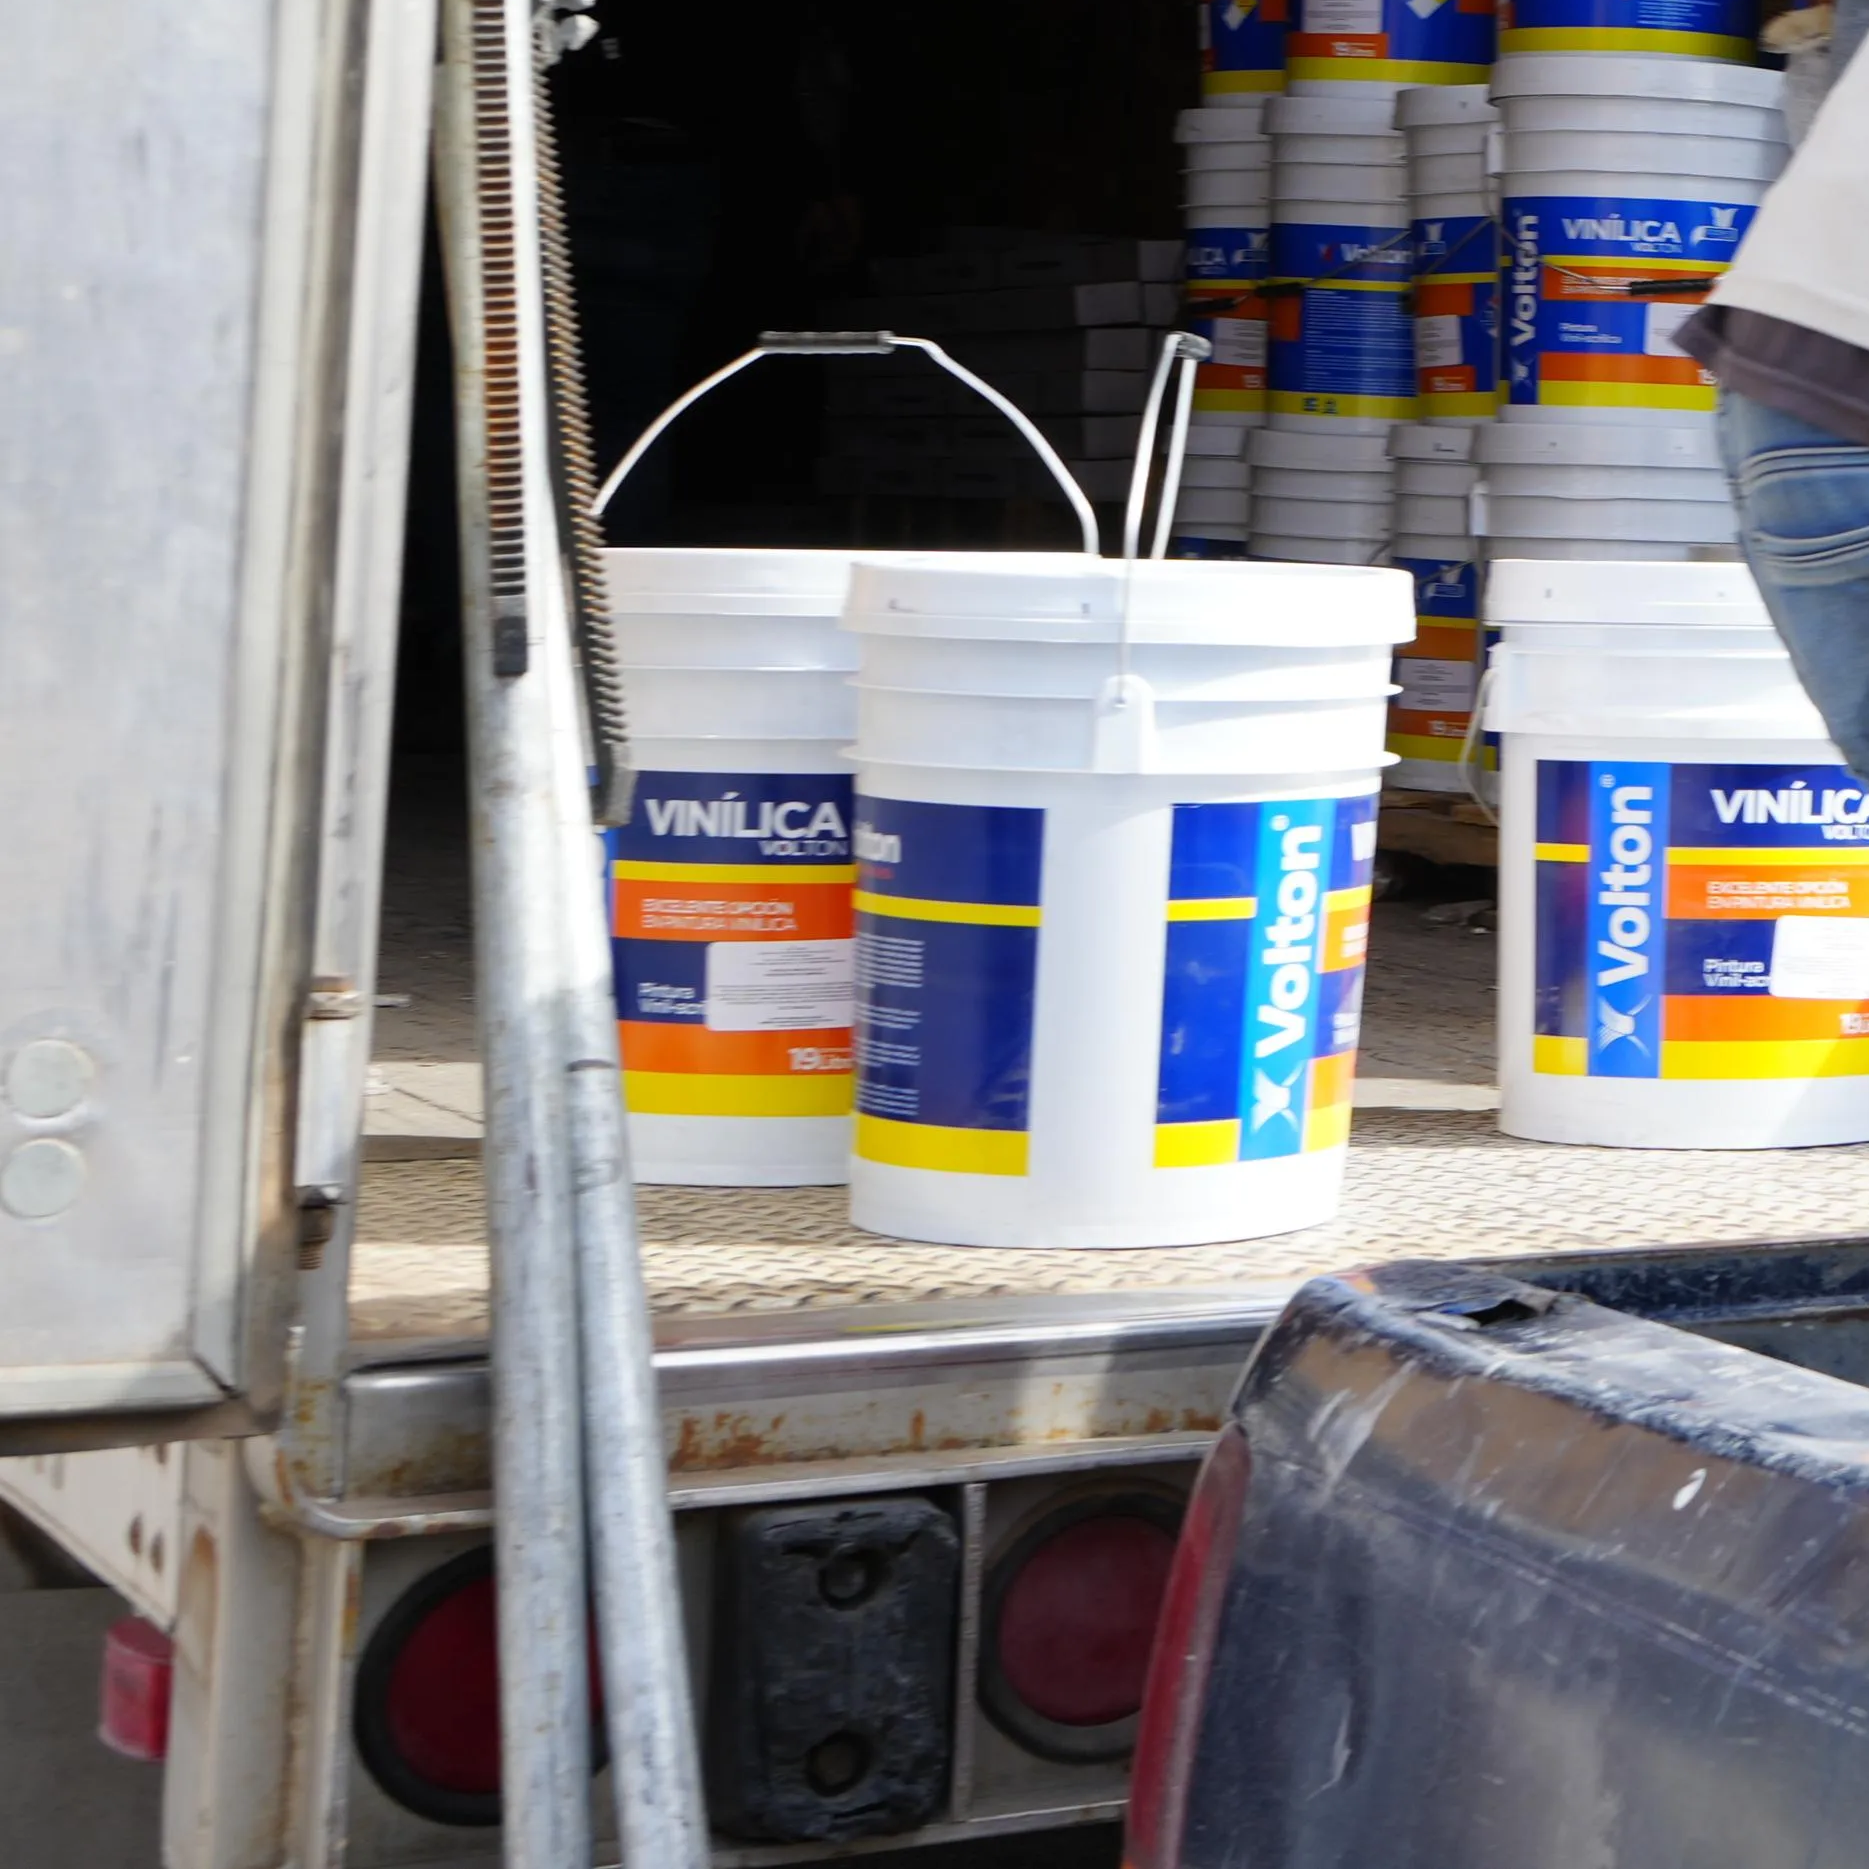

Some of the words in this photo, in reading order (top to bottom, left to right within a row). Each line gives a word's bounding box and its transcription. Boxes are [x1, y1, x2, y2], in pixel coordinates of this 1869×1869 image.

[1561, 213, 1683, 244] VINÍLICA
[1510, 215, 1540, 347] Volton
[644, 791, 848, 838] VINÍLICA
[758, 840, 849, 856] VOLTON
[1597, 786, 1654, 987] Volton
[1255, 825, 1323, 1059] Volton
[1703, 958, 1765, 973] Pintura
